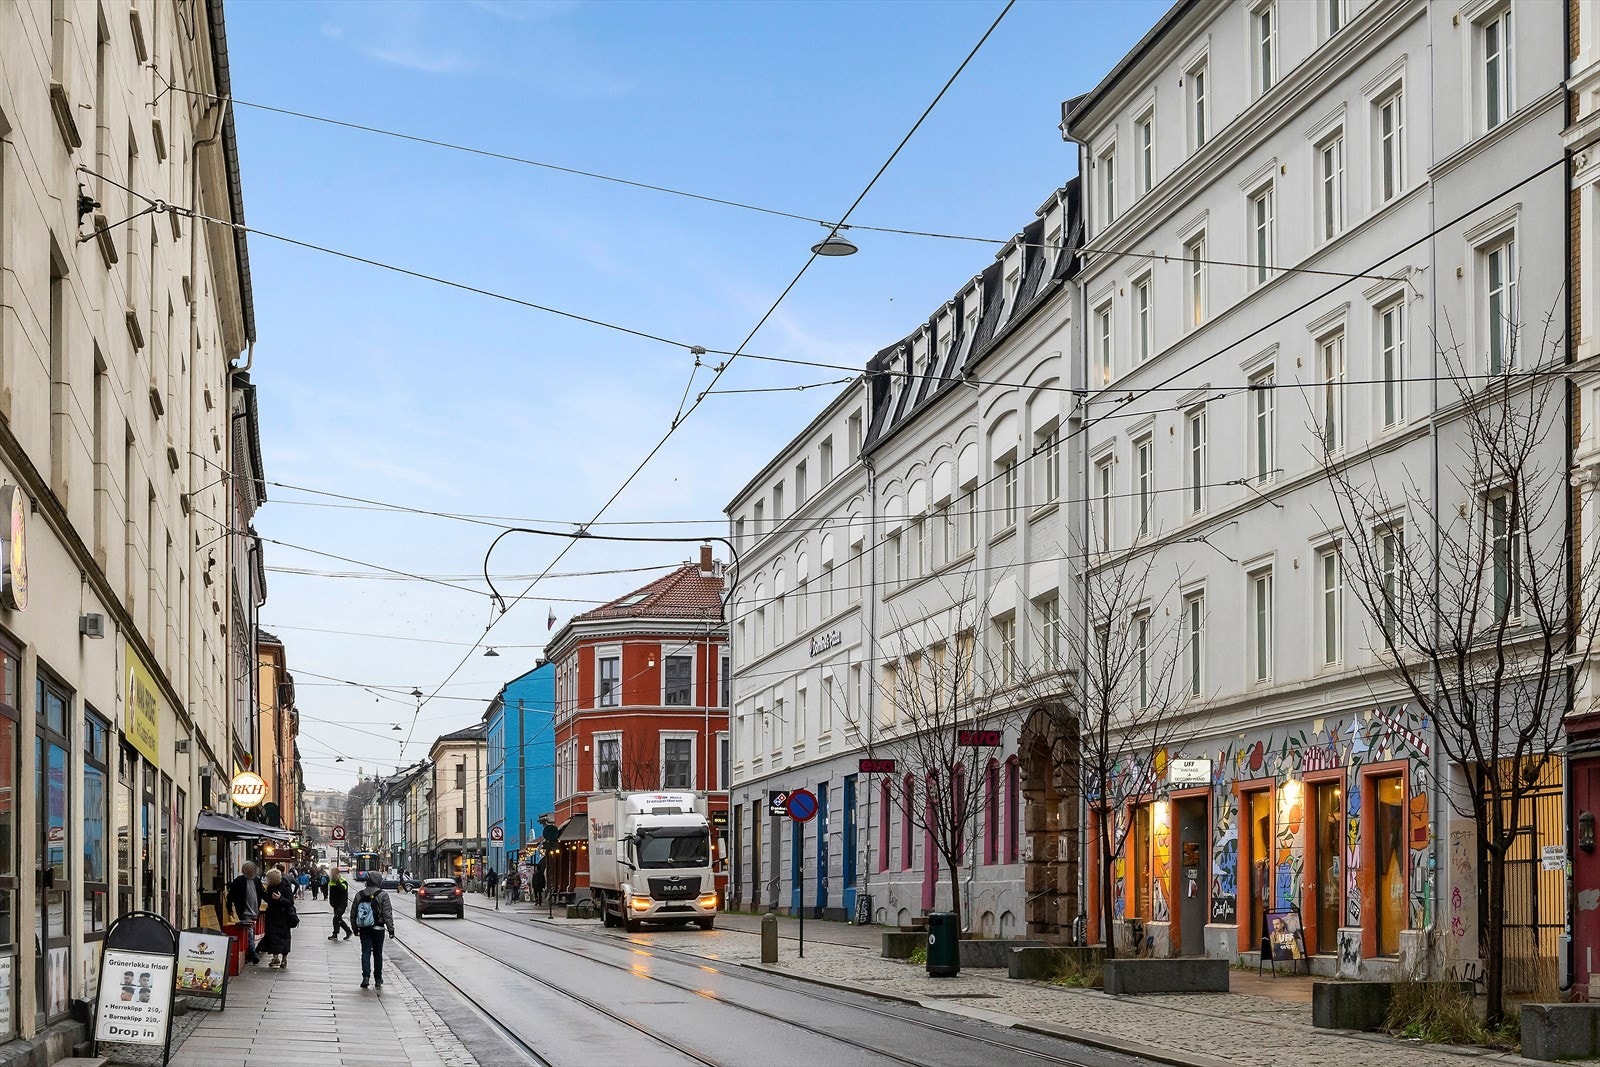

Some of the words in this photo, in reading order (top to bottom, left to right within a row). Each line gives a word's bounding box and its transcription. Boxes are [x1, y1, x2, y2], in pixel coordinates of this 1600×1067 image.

[232, 784, 263, 795] BKH
[1279, 933, 1294, 942] UFF
[108, 959, 150, 969] Grünerløkka
[110, 1004, 142, 1012] Herreklipp
[108, 1013, 143, 1022] Barneklipp
[109, 1026, 139, 1038] Drop
[142, 1029, 155, 1037] in
